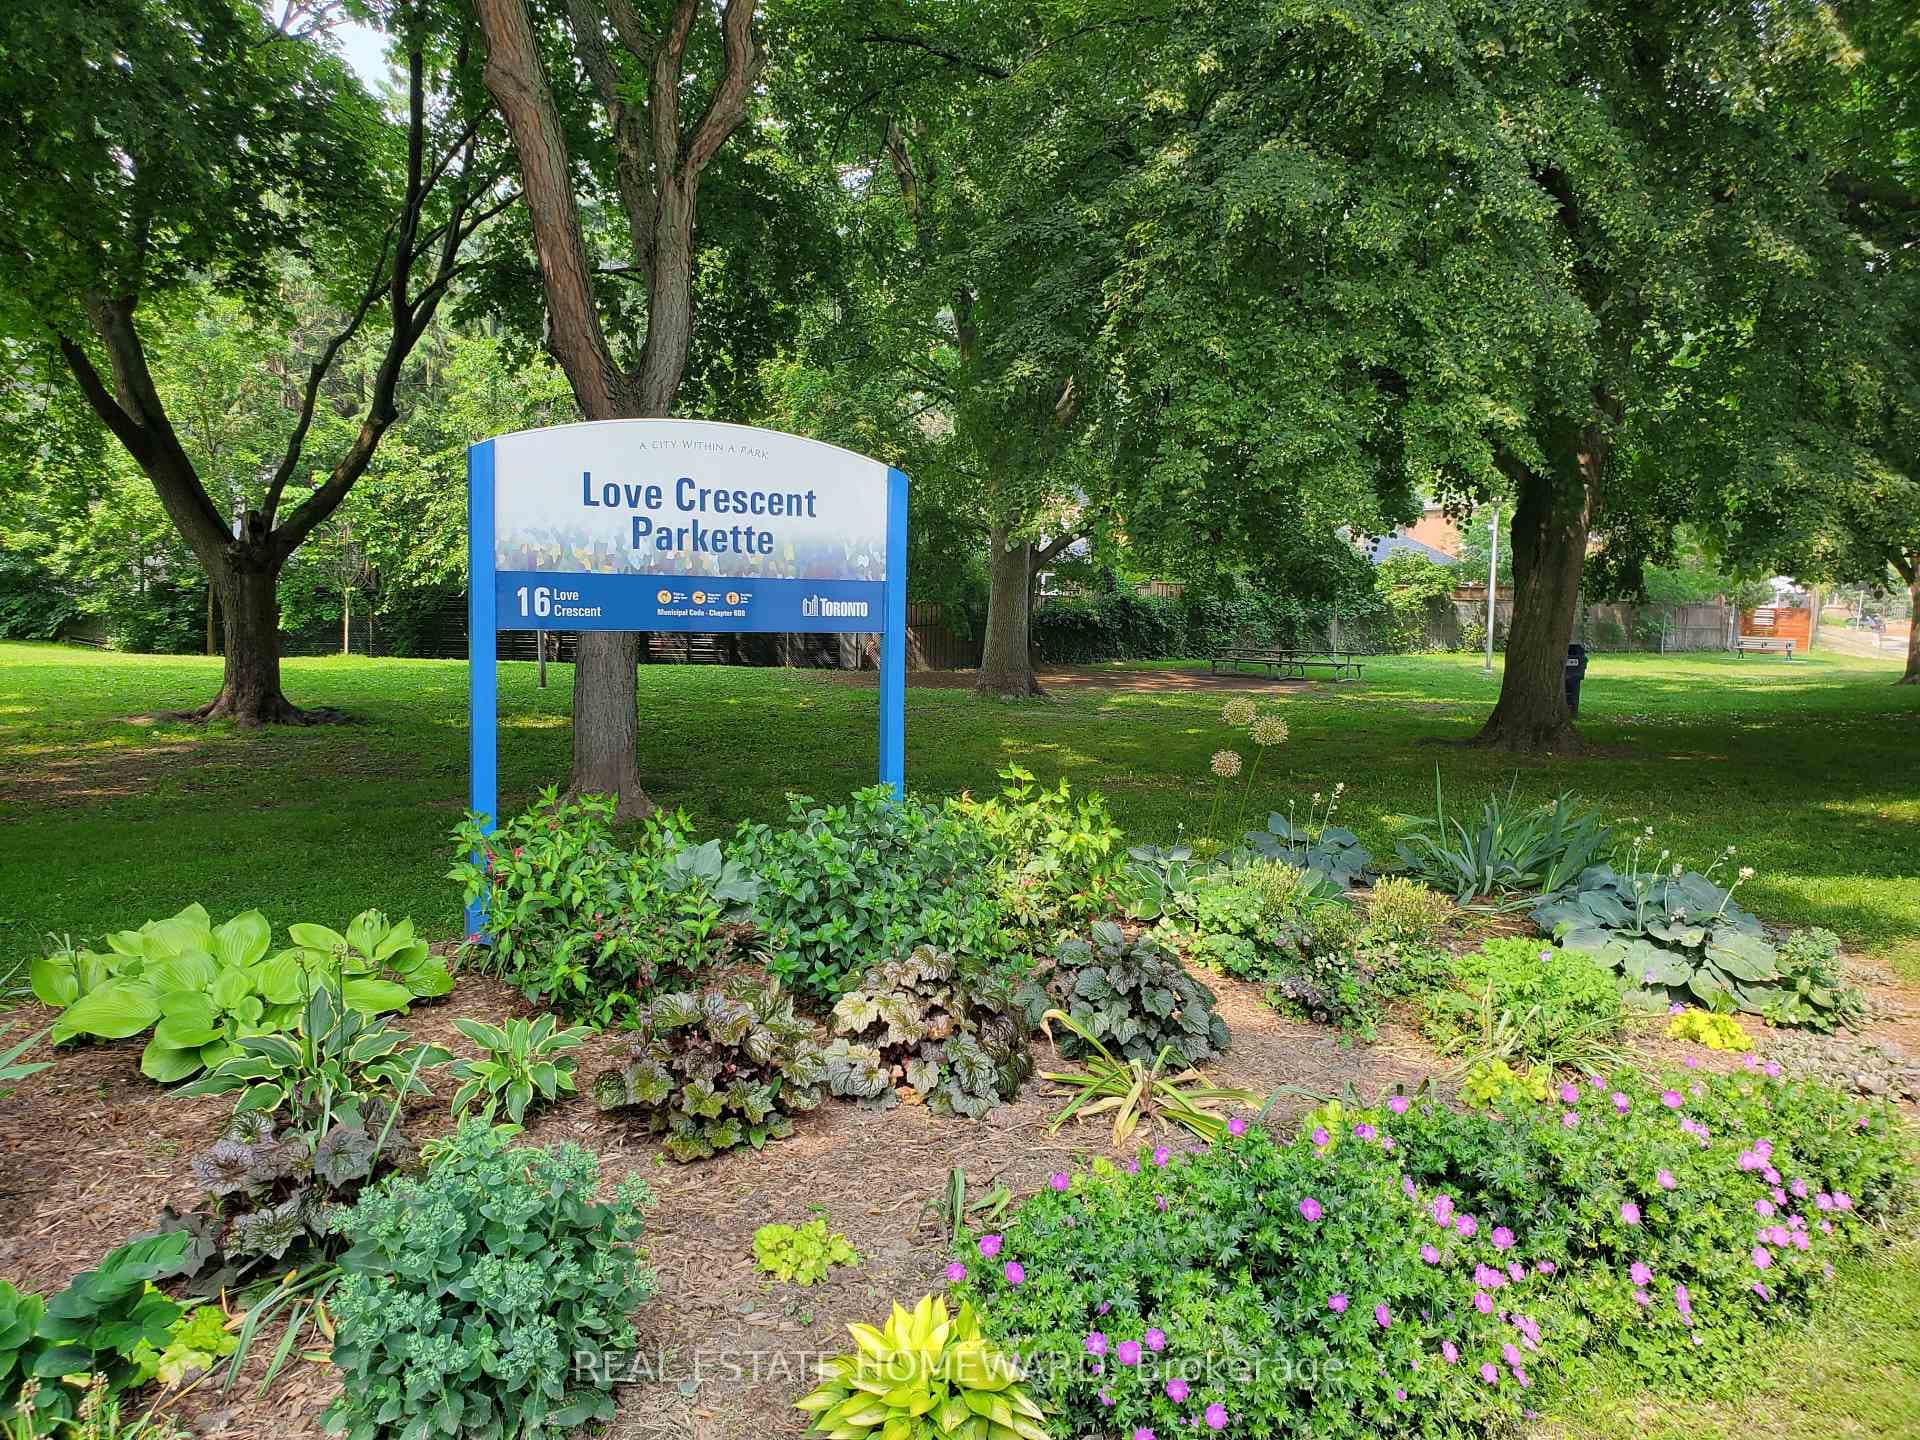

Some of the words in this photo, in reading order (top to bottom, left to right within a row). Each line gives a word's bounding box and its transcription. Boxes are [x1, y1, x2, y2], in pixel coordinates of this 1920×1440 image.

[652, 440, 678, 449] CITY
[682, 440, 723, 453] WITHIN
[740, 445, 768, 460] PARK
[583, 472, 663, 509] Love
[675, 477, 816, 517] Crescent
[632, 516, 774, 554] Parkette
[517, 586, 550, 617] 16
[554, 588, 579, 601] Love
[554, 604, 601, 617] Crescent
[657, 608, 688, 617] Municipal
[709, 609, 733, 618] Chapter
